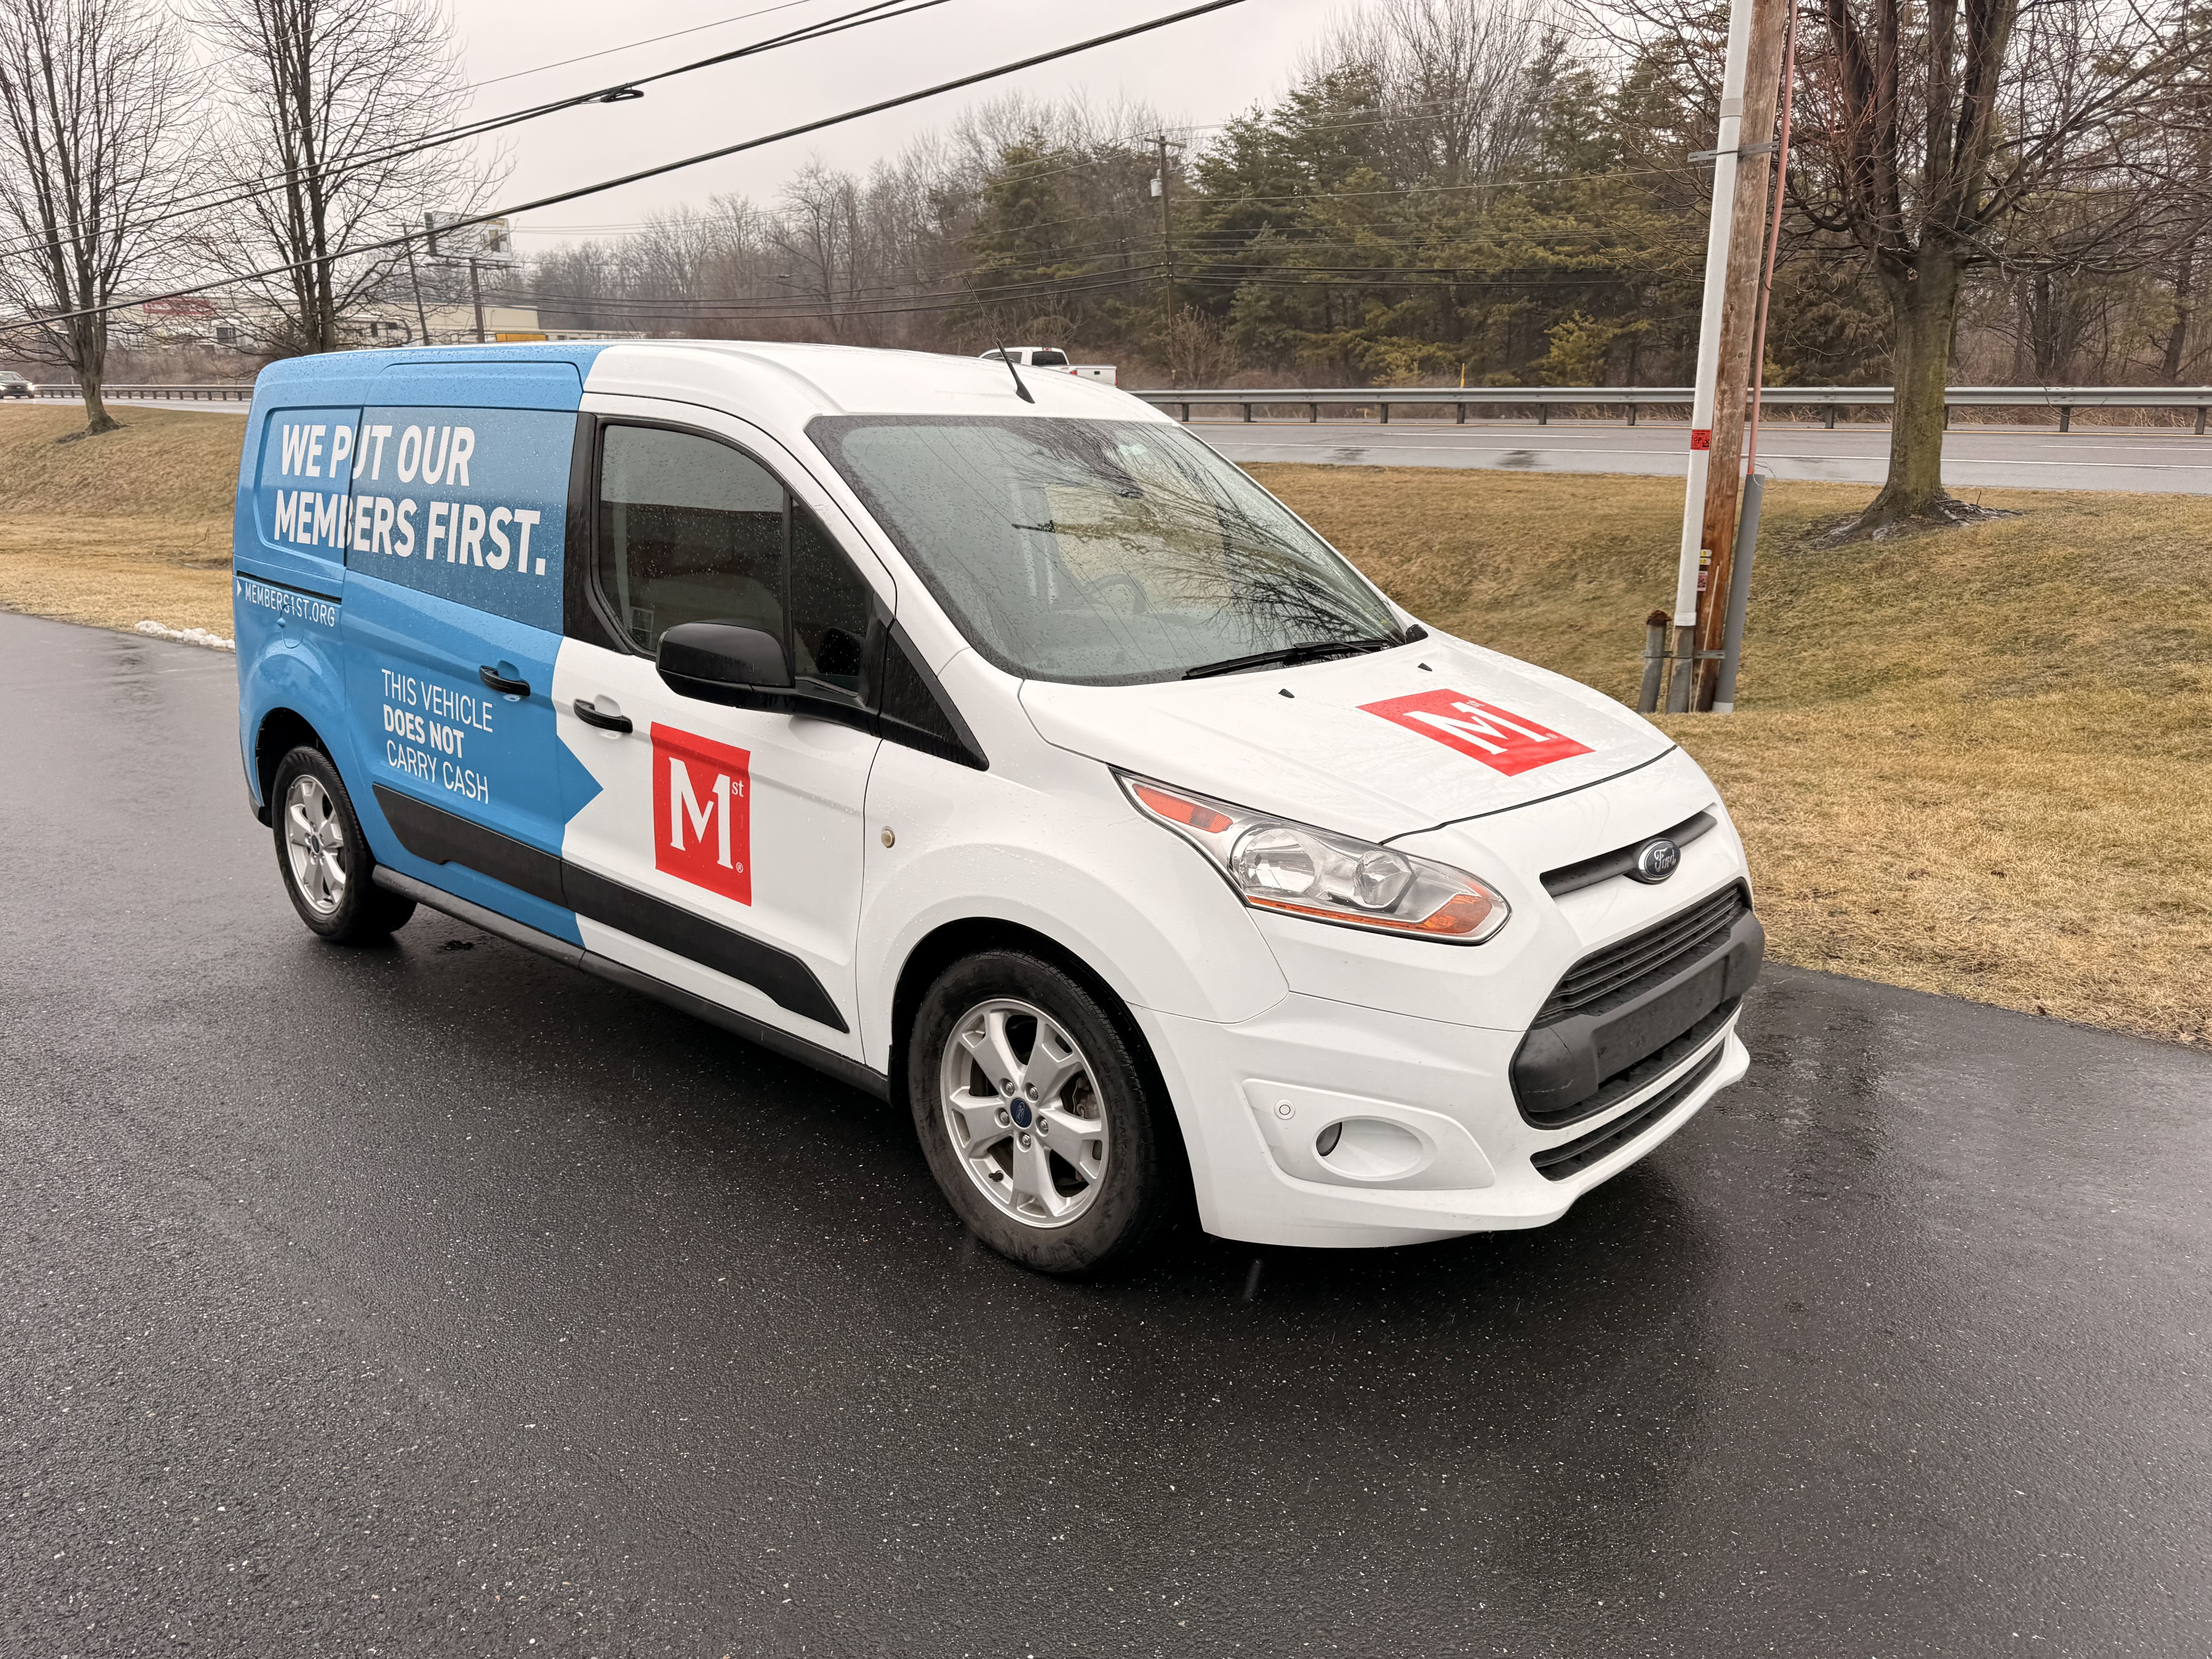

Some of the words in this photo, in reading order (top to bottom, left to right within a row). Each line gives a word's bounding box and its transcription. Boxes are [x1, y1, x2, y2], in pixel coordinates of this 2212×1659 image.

[282, 424, 326, 477] WE
[329, 425, 393, 480] PUT
[397, 425, 475, 486] OUR
[274, 490, 418, 557] MEMBERS
[426, 501, 546, 575] FIRST.
[245, 582, 335, 627] MEMBERS1ST.ORG
[381, 668, 417, 706] THIS
[421, 682, 493, 733] VEHICLE
[383, 704, 425, 744] DOES
[429, 721, 464, 758] NOT
[386, 740, 437, 783] CARRY
[443, 761, 489, 804] CASH
[1654, 847, 1676, 872] Ford
